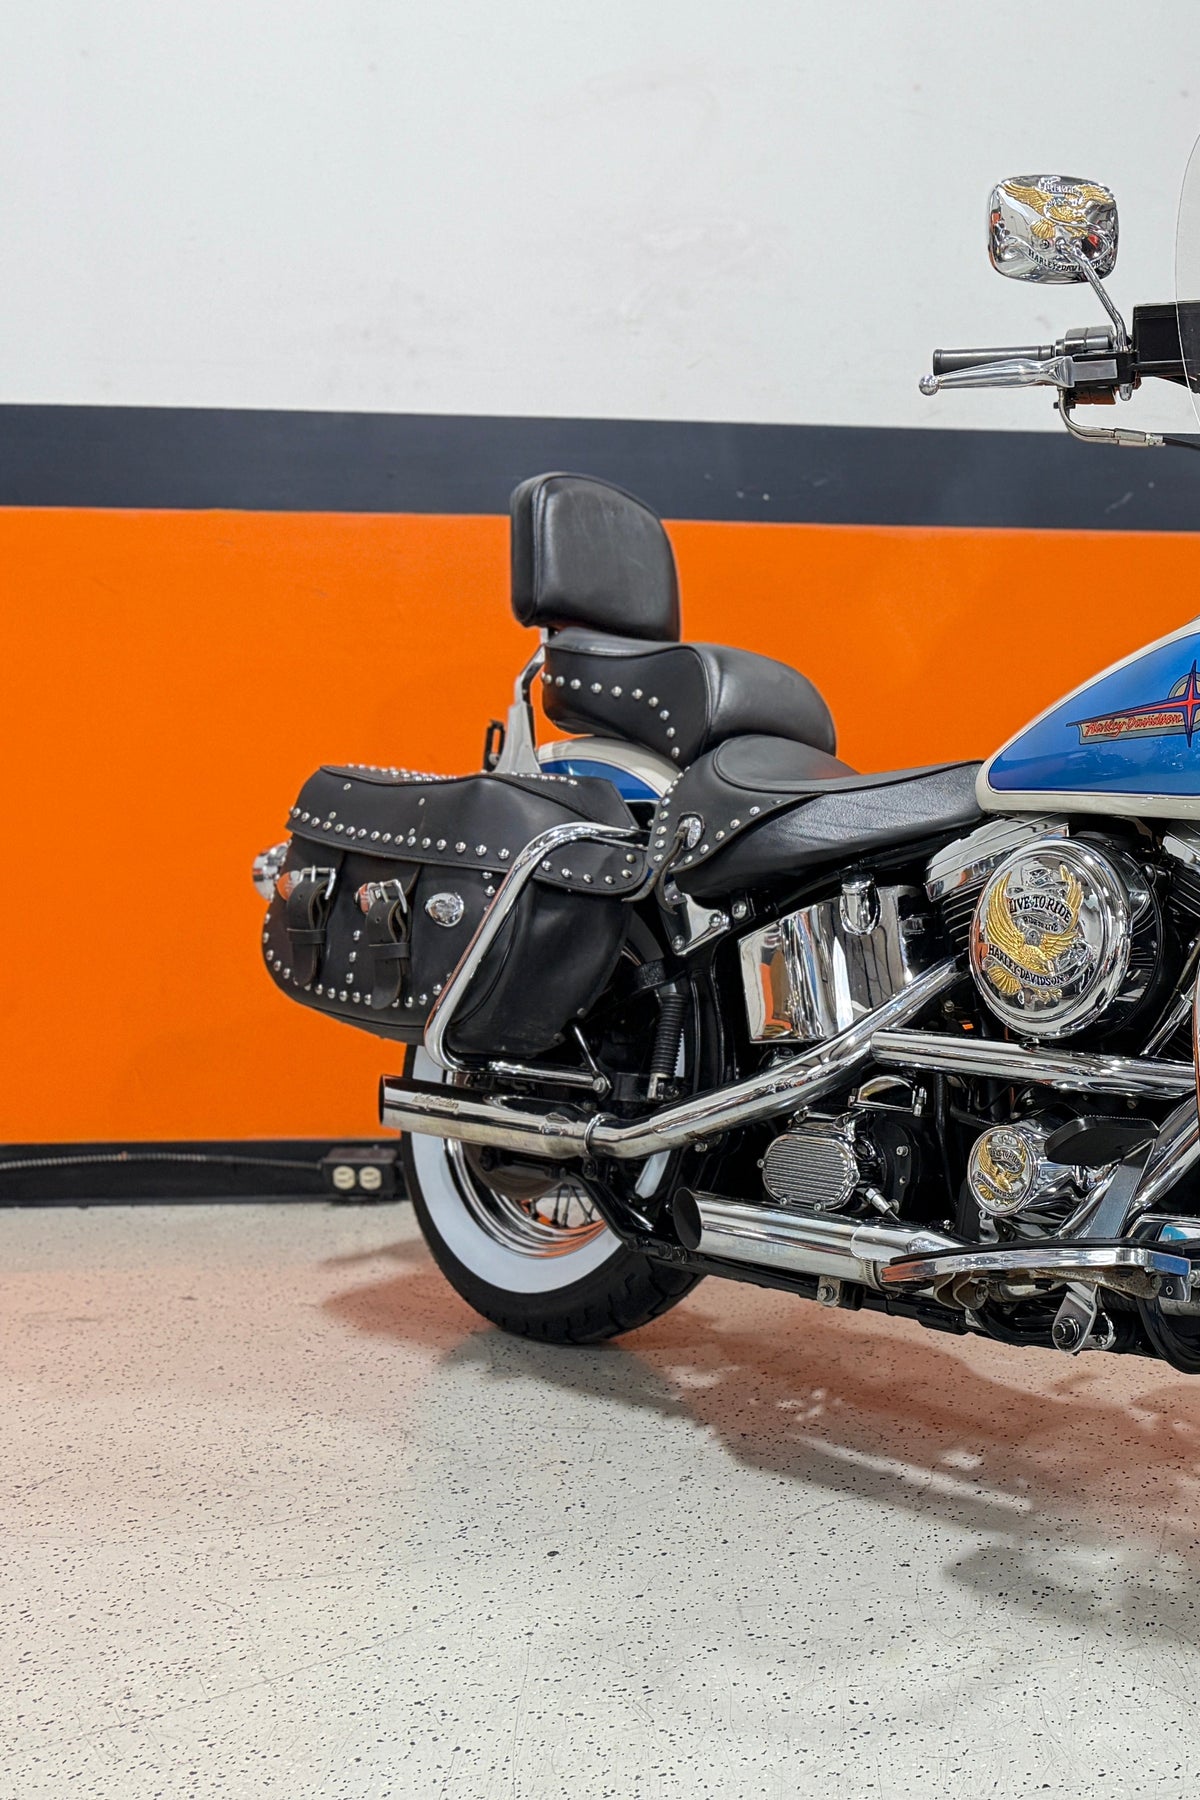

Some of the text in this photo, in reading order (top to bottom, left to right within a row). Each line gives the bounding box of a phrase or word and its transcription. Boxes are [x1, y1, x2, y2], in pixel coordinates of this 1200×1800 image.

[1009, 895, 1072, 924] LIVE TO RIDE
